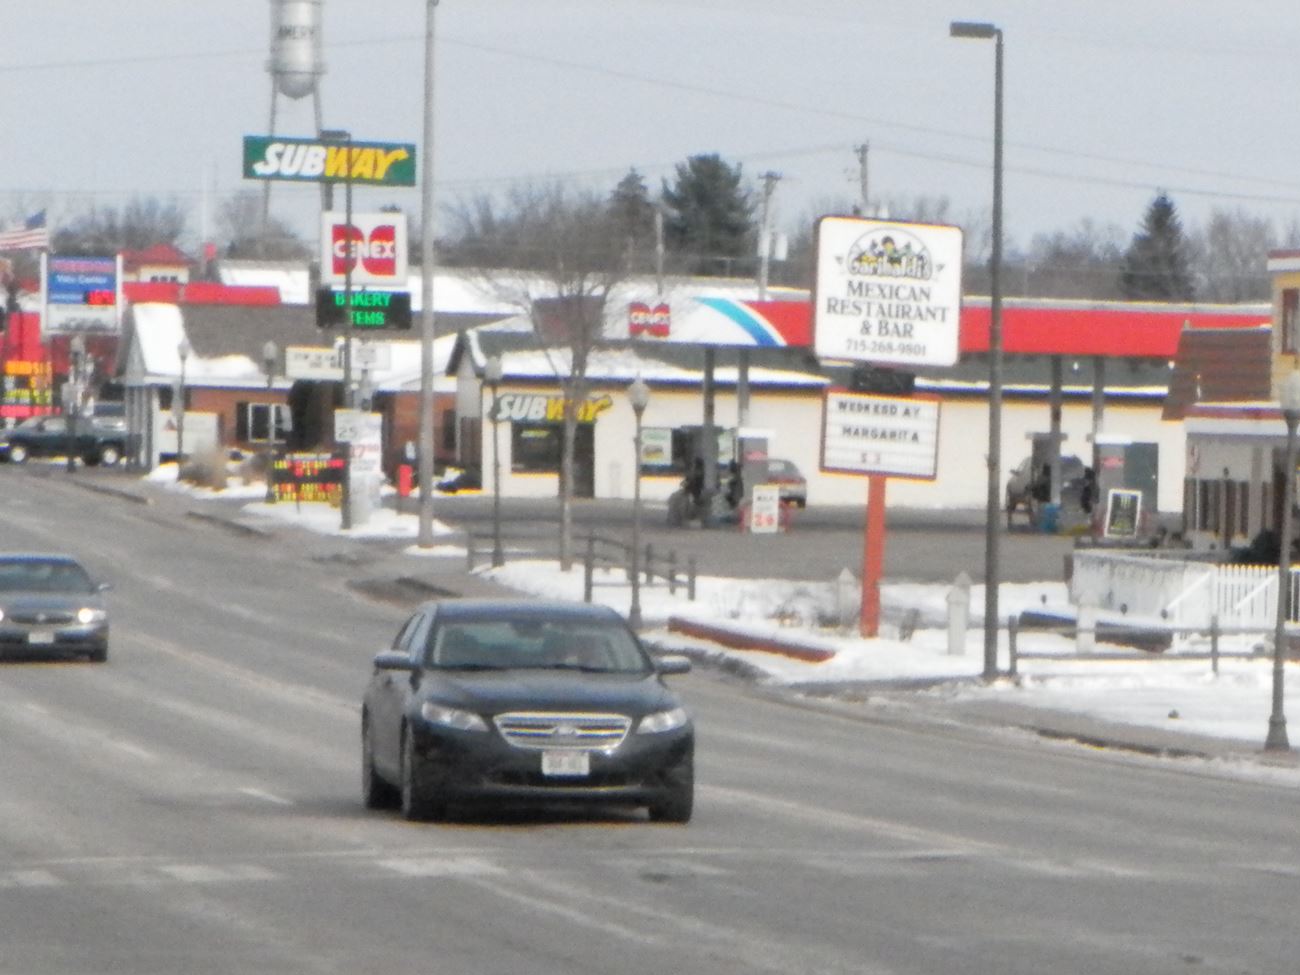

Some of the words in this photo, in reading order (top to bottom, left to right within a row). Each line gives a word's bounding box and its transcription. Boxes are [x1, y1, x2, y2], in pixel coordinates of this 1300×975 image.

[253, 142, 408, 180] SUBWAY
[846, 279, 932, 302] MEXICAN
[826, 296, 949, 323] RESTAURANT
[860, 321, 871, 336] &
[877, 320, 914, 338] BAR
[842, 426, 919, 442] MARGARITA
